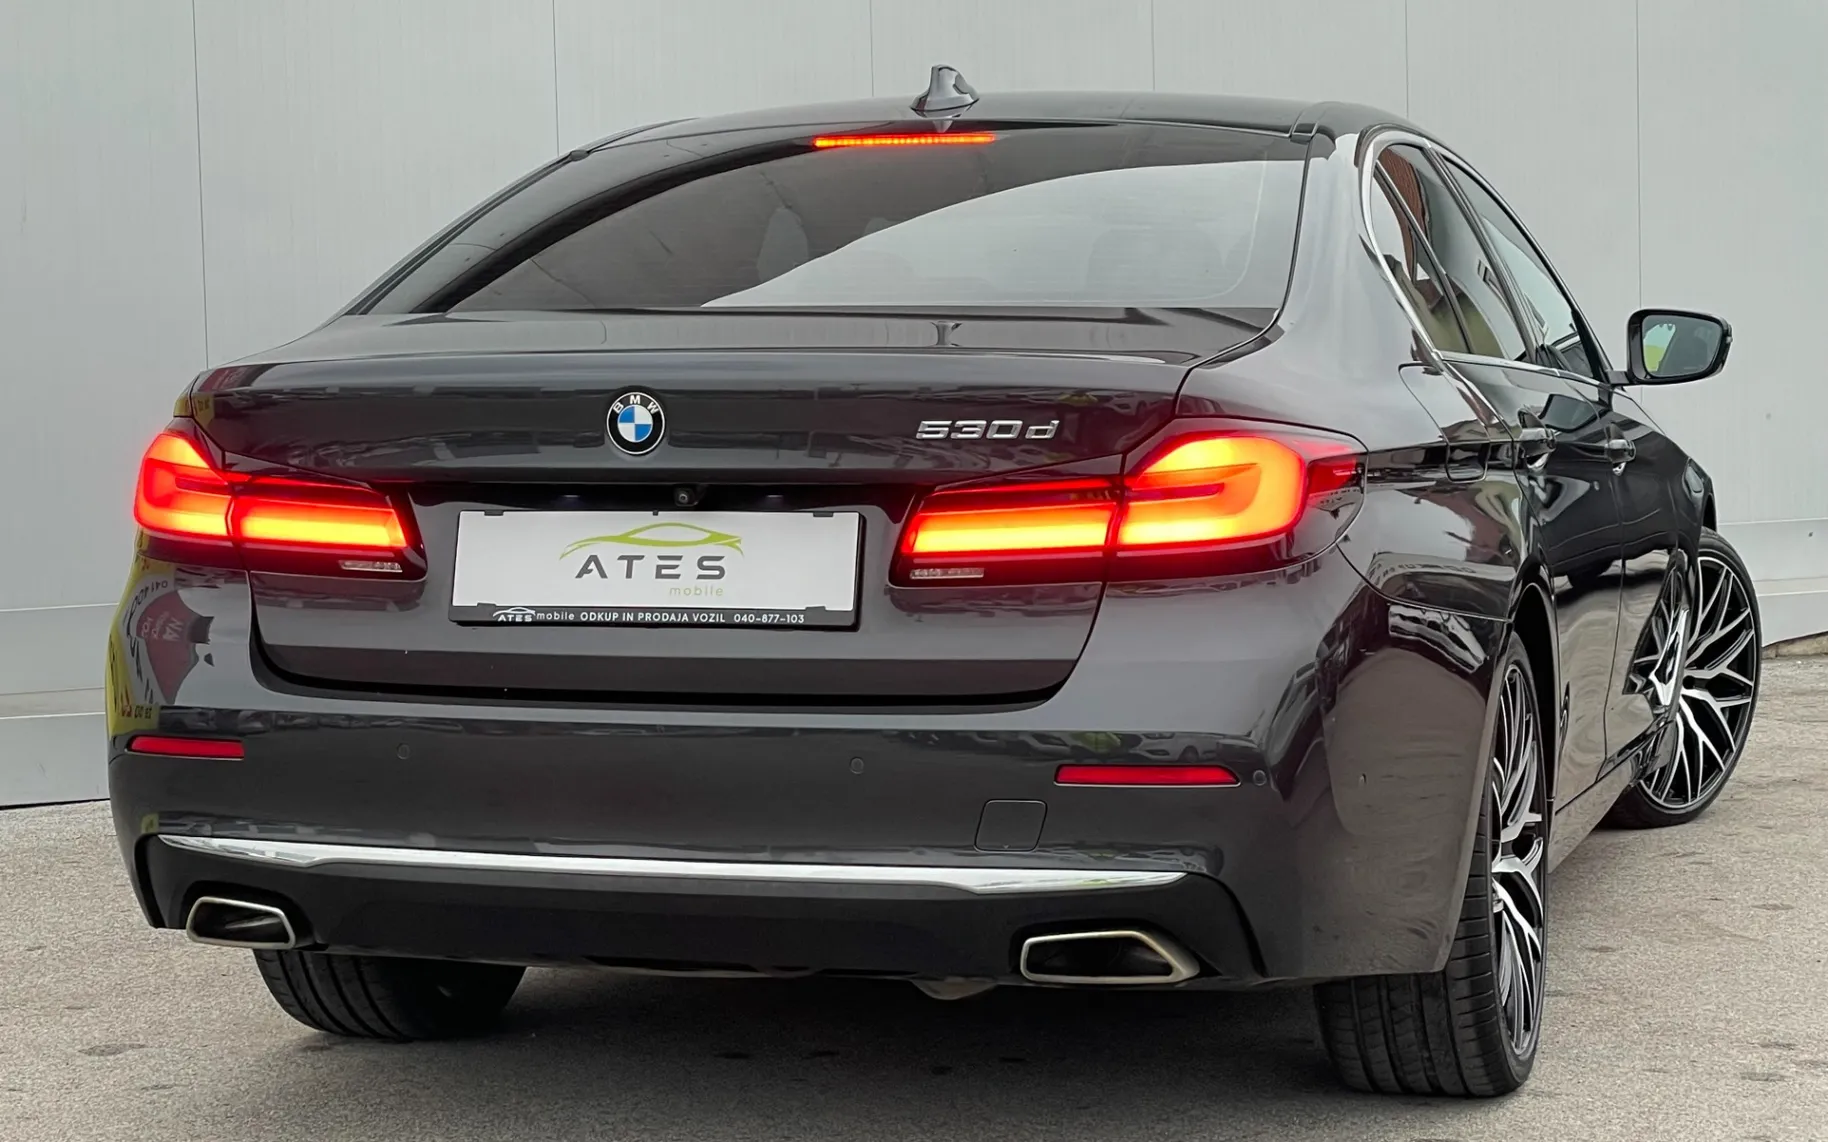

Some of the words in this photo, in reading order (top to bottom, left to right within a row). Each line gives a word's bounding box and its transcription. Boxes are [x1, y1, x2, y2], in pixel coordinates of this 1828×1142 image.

[612, 394, 660, 415] BMW
[915, 419, 1060, 440] 530d
[574, 554, 726, 580] ATES
[668, 585, 724, 596] mobile
[497, 614, 533, 623] ATES
[536, 611, 575, 621] mobile
[580, 612, 619, 622] ODKUP
[622, 612, 635, 622] IN
[637, 612, 689, 623] PRODAJA
[692, 613, 726, 623] VOZIL
[733, 613, 805, 624] 040-877-103
